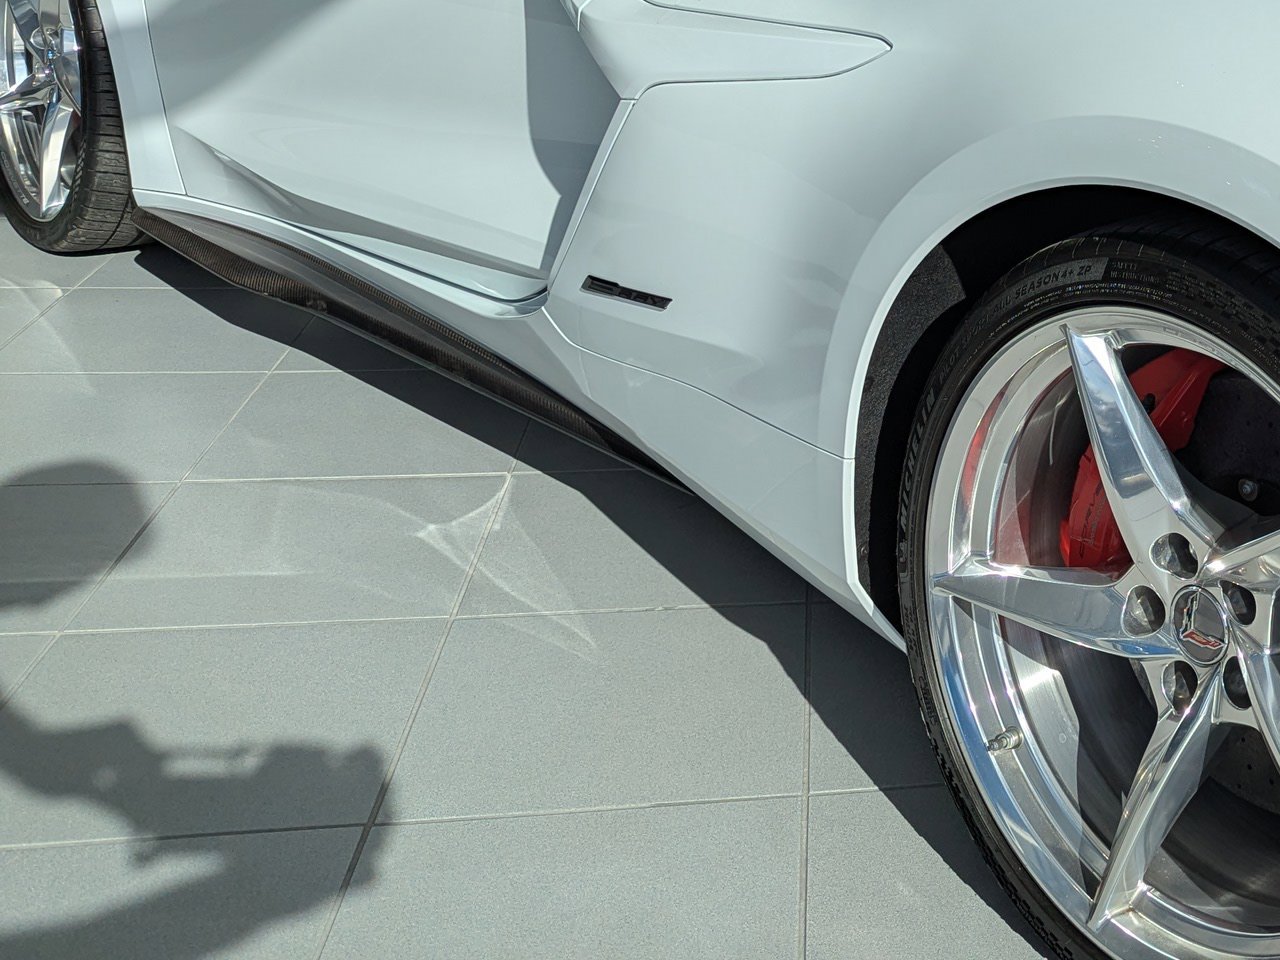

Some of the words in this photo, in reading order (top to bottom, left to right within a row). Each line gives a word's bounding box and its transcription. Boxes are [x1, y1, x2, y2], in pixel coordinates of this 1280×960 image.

[900, 385, 937, 530] MICHELIN
[1015, 269, 1061, 300] SEASON
[1061, 268, 1074, 280] 4+
[1077, 264, 1093, 276] ZP
